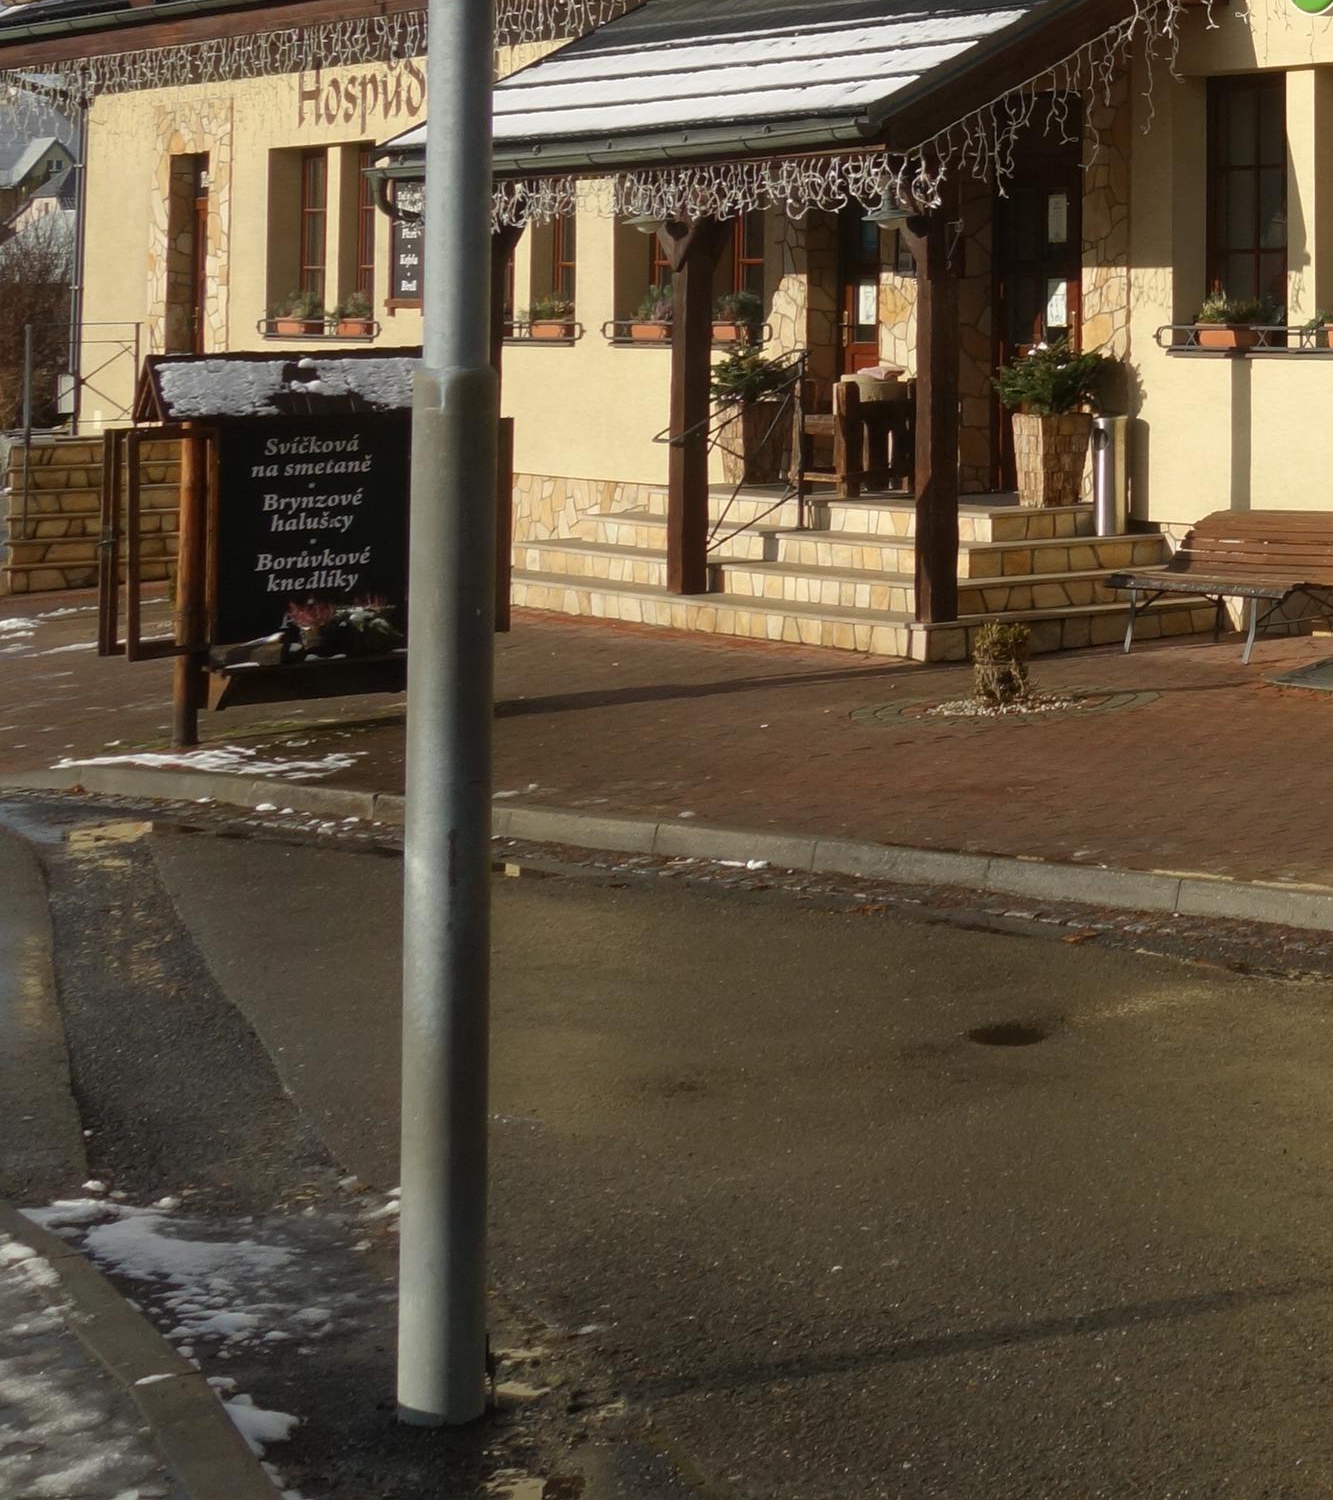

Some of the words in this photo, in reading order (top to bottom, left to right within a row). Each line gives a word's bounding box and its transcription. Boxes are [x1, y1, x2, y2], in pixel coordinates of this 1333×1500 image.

[298, 50, 427, 136] Hospůd
[264, 434, 360, 456] Svíčková
[251, 464, 278, 478] na
[284, 454, 373, 477] smetaně
[262, 487, 364, 515] Brynzové
[254, 546, 371, 572] Borůvkové
[266, 568, 359, 592] knedlíky
